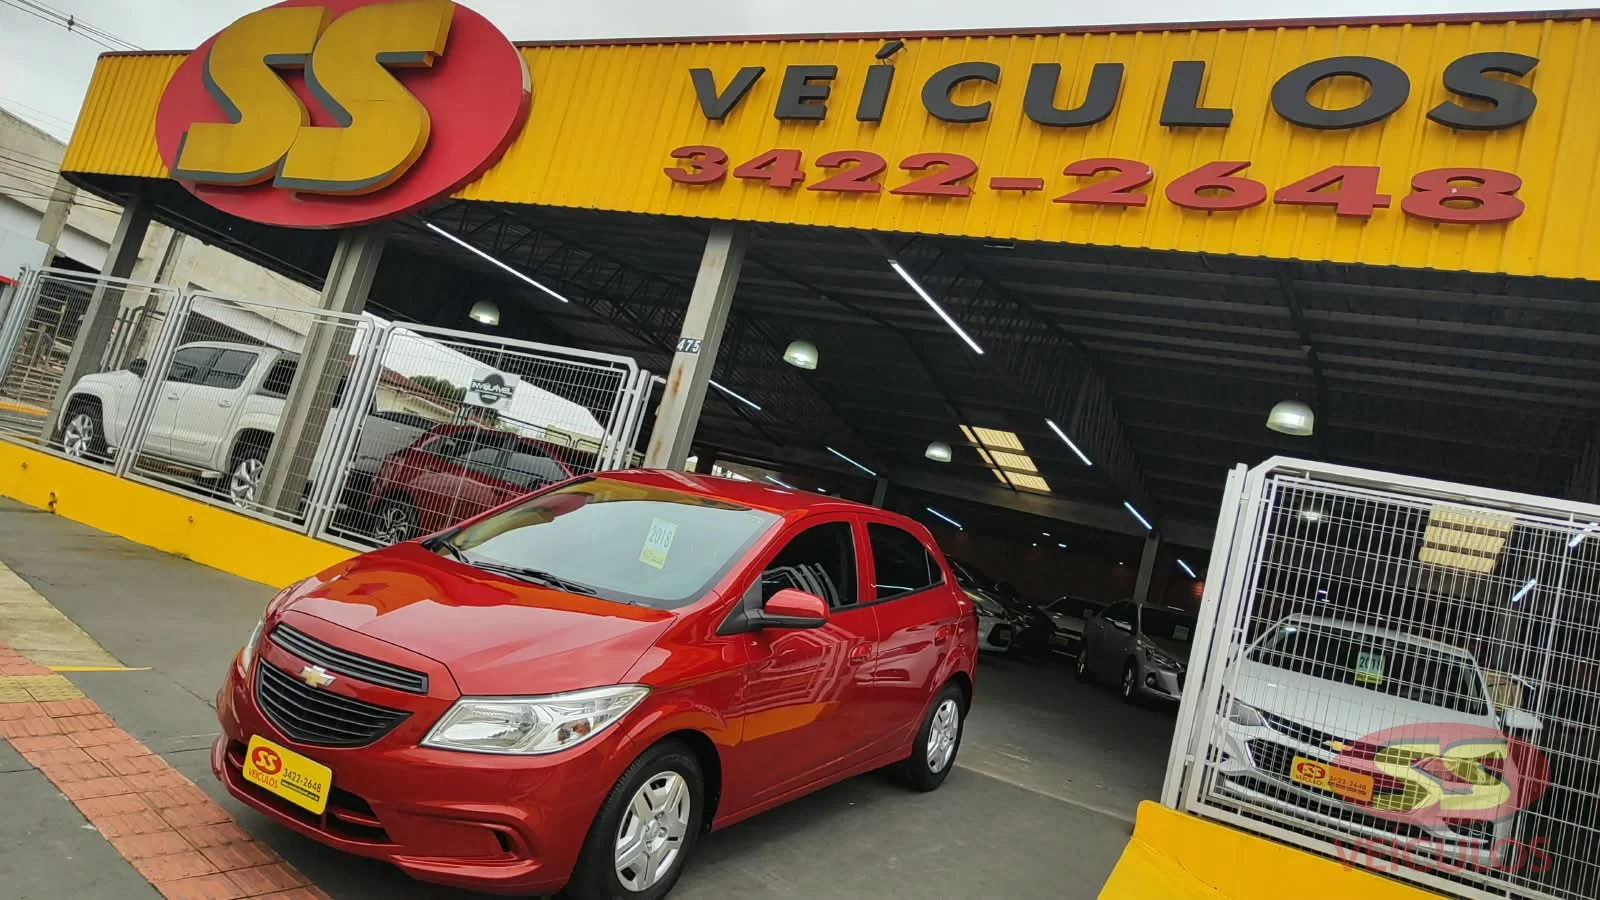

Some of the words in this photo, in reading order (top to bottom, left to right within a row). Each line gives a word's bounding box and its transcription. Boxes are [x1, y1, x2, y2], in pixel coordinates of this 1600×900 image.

[171, 0, 456, 196] SS
[688, 40, 1540, 131] VEÍCULOS
[664, 145, 1525, 224] 3422-2648
[677, 338, 701, 353] 475
[649, 526, 673, 548] 2018
[255, 750, 278, 771] SS
[282, 768, 322, 793] 3422-2648
